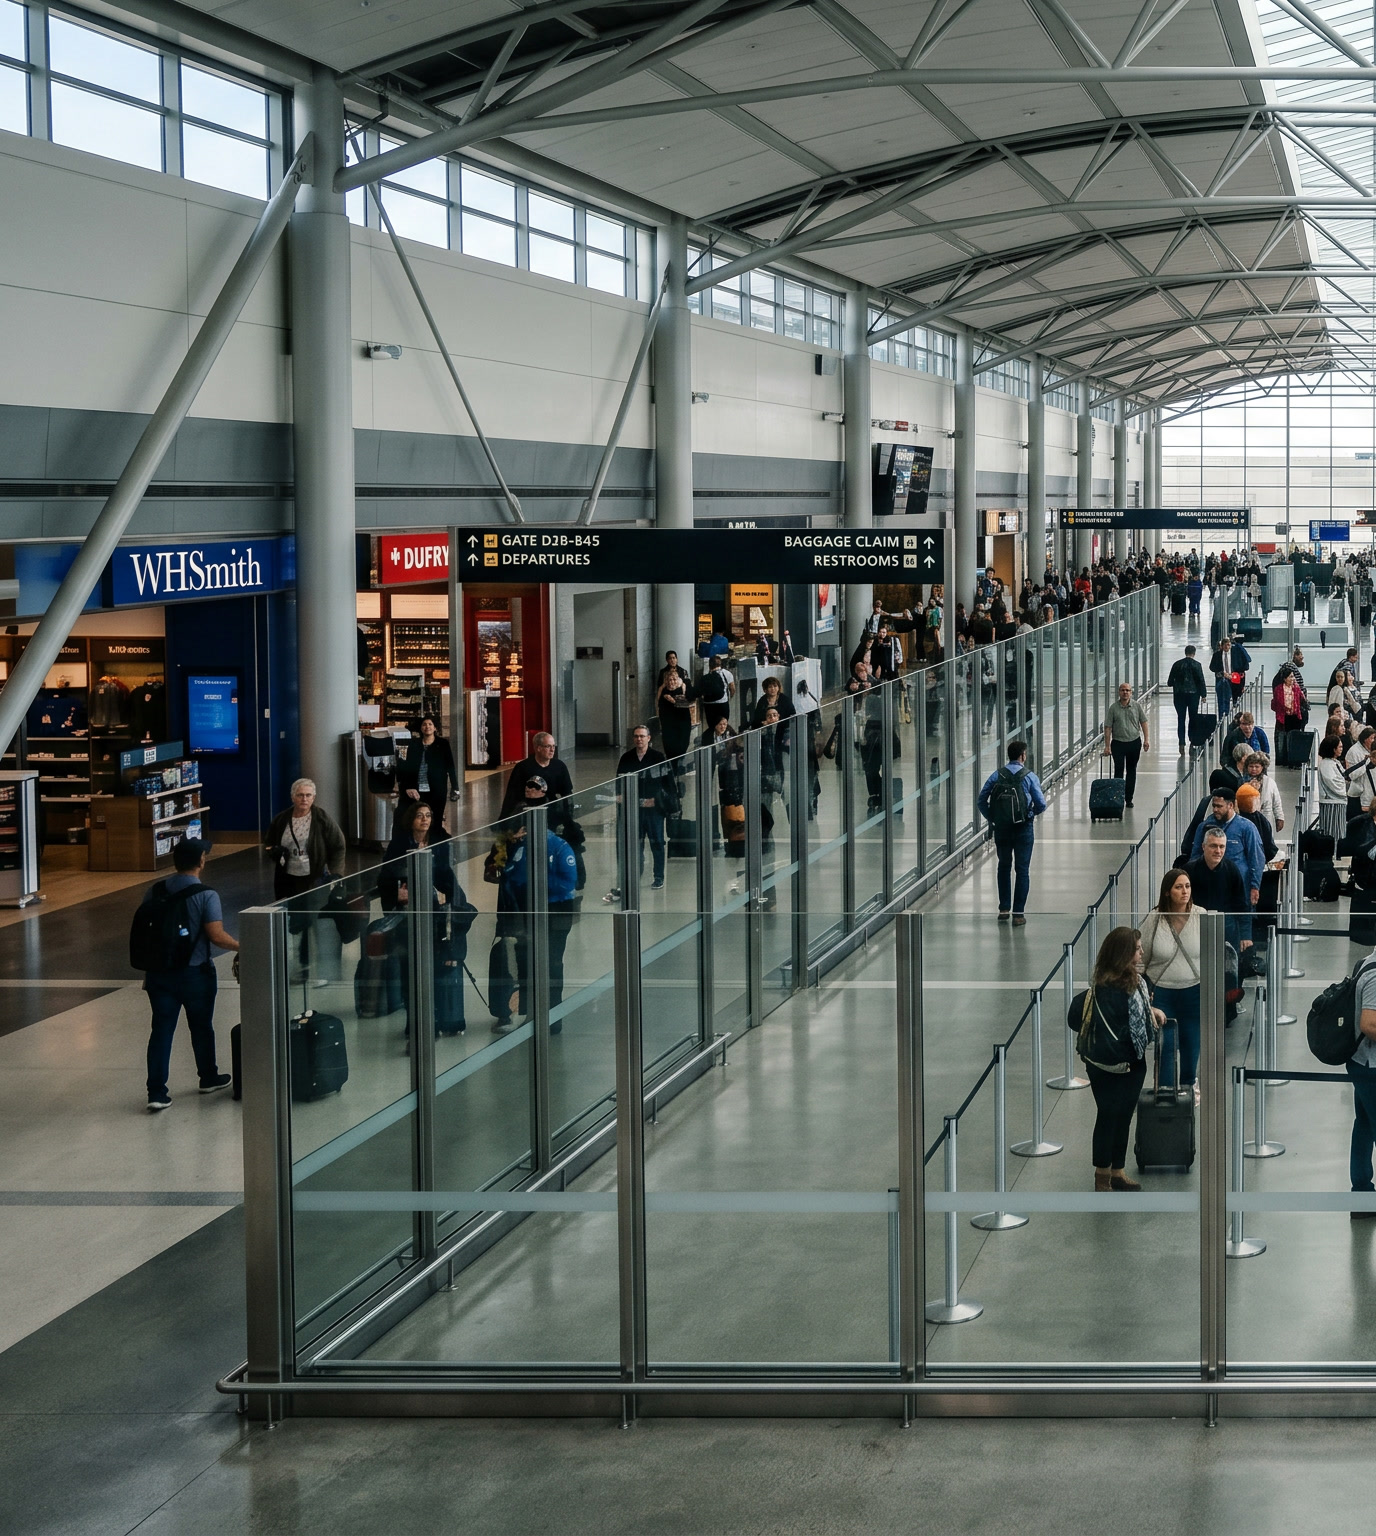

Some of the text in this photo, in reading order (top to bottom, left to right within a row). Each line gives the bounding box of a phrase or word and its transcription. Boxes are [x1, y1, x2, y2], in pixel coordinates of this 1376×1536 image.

[501, 534, 537, 547] GATE
[784, 536, 899, 548] BAGGAGE CLAIM
[404, 545, 449, 570] DUFRY
[502, 553, 591, 566] DEPARTURES
[814, 555, 899, 567] RESTROOMS
[129, 548, 263, 596] WHSmith
